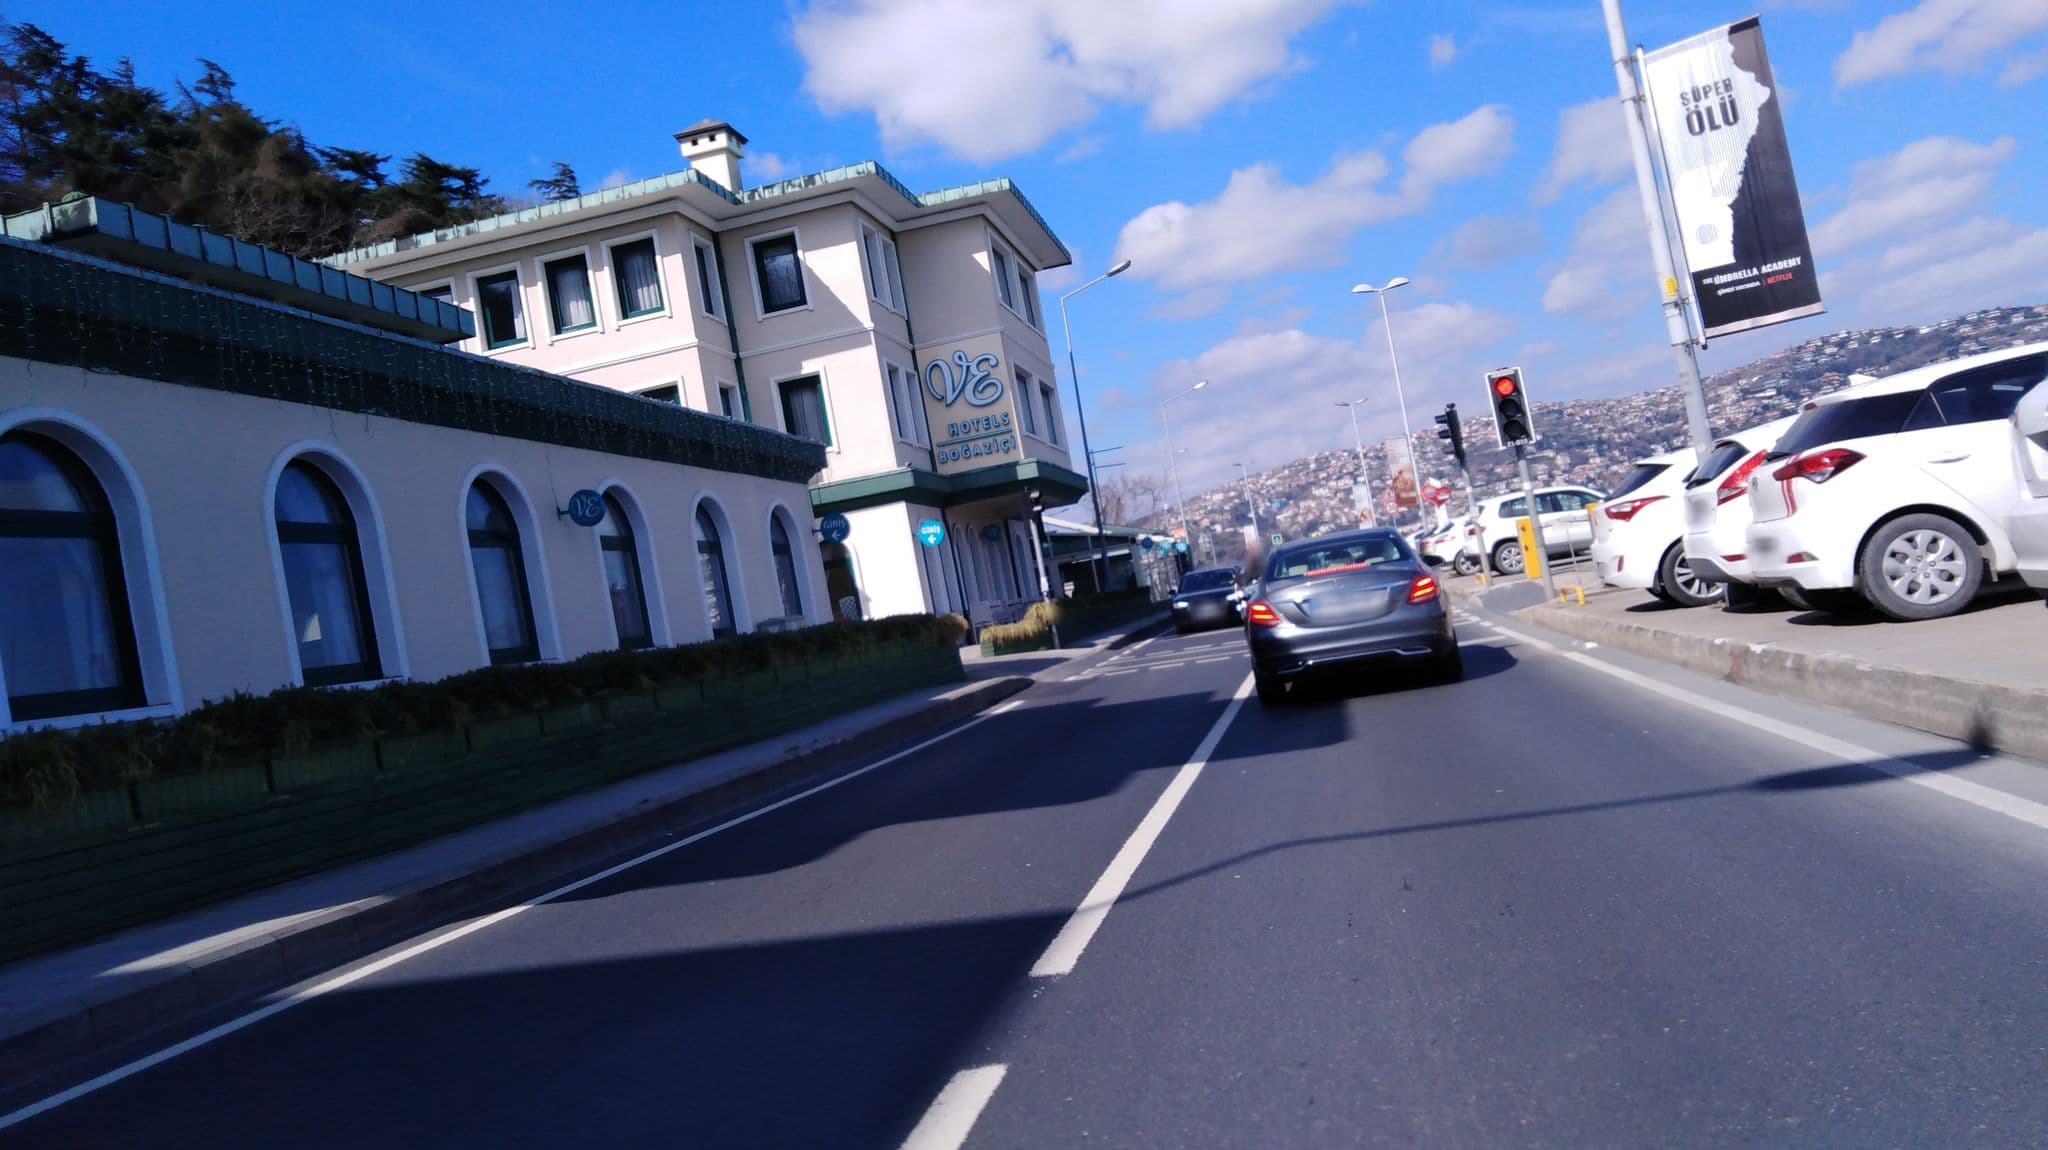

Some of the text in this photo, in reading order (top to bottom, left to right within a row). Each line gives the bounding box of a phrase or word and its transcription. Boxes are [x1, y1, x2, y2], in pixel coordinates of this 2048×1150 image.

[1680, 77, 1733, 106] SÜPER
[1686, 94, 1740, 136] ÖLÜ
[1761, 256, 1801, 274] ACADEMY
[1766, 272, 1793, 285] NETFLIX
[925, 349, 1004, 407] VE
[948, 412, 1010, 437] HOTELS
[937, 434, 1017, 464] BOĞAZİÇİ
[572, 494, 601, 518] VE
[823, 519, 846, 529] GİRİŞ
[921, 525, 941, 535] GİRİŞ
